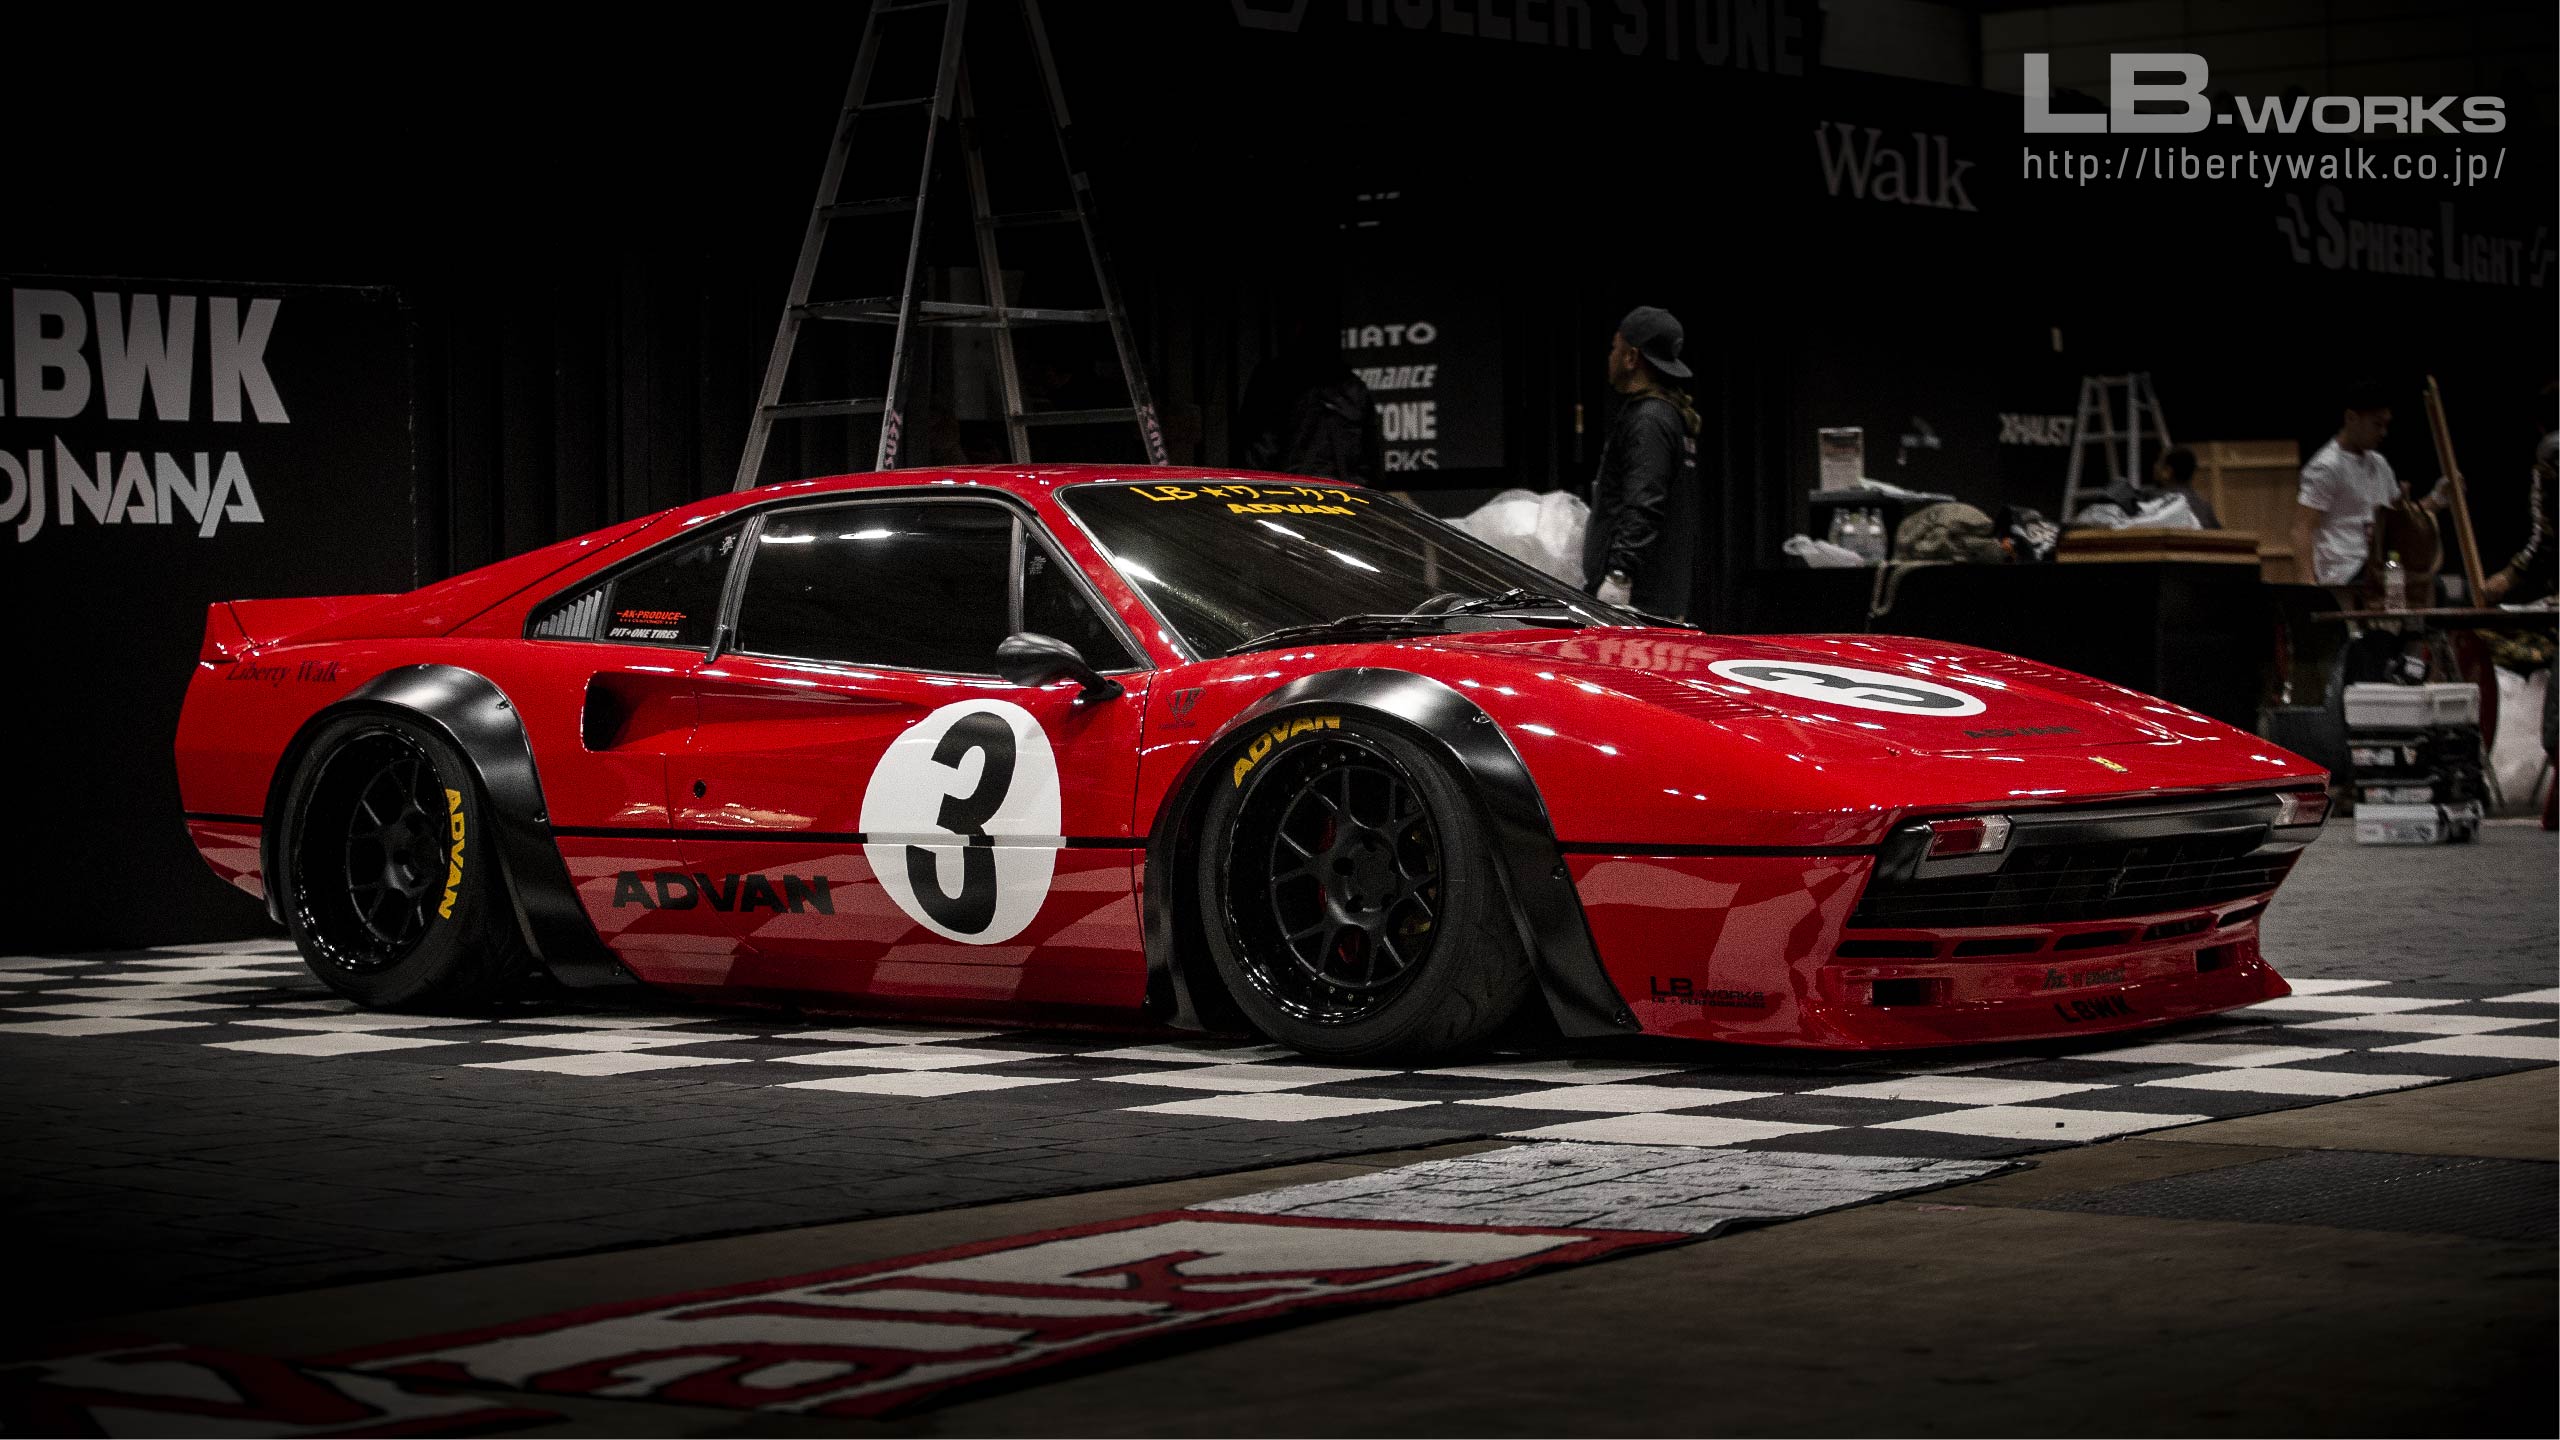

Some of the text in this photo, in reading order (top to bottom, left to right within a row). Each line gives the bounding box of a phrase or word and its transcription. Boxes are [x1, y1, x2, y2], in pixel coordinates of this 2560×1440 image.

[1610, 0, 1805, 78] STONE
[1813, 120, 1980, 212] Walk
[0, 287, 291, 424] BWK
[1340, 322, 1438, 350] IATO
[1226, 503, 1356, 516] ADVAN
[1728, 666, 1965, 709] 3
[1232, 715, 1342, 789] ADVAN
[437, 787, 466, 921] ADVAN
[905, 711, 1017, 935] 3
[613, 870, 835, 915] ADVAN
